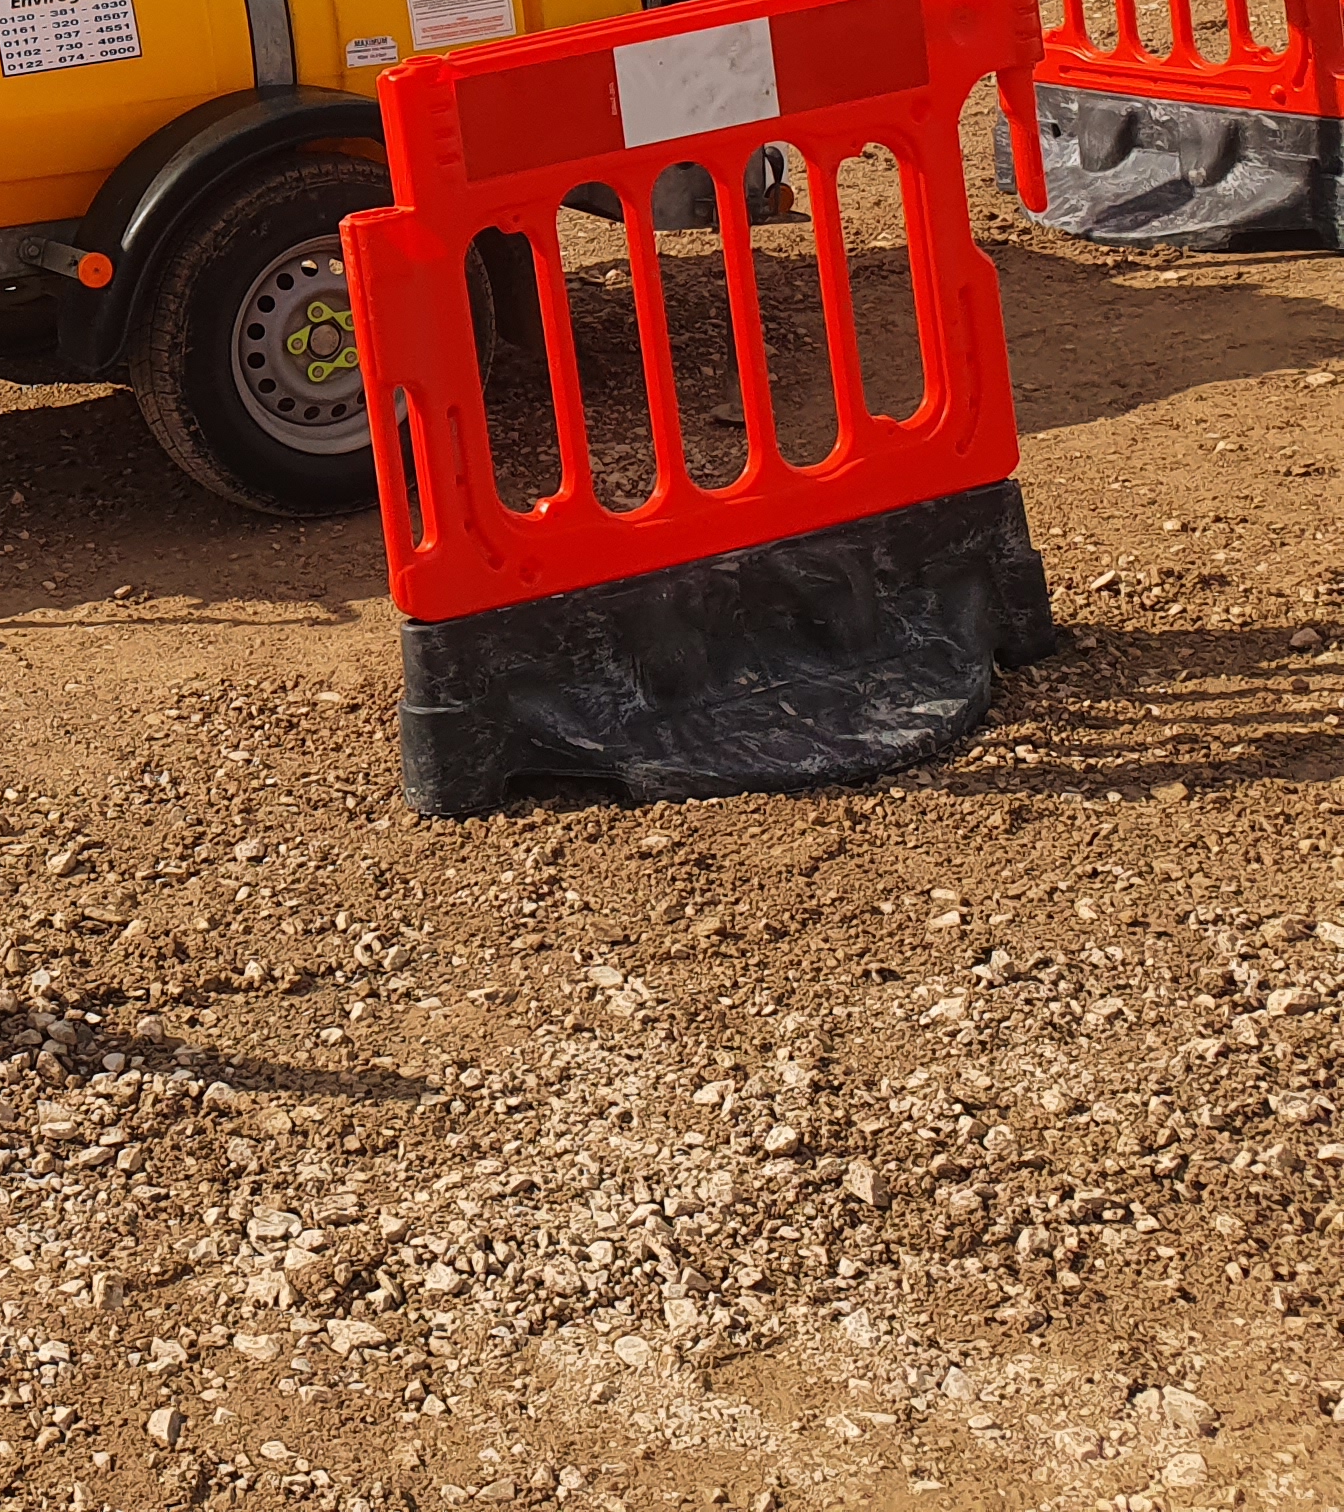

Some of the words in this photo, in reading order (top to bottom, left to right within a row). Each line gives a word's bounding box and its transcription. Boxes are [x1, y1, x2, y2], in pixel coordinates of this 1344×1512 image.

[0, 13, 35, 24] 0130
[92, 0, 127, 10] 4930
[1, 25, 36, 36] 0161
[52, 19, 79, 28] 320
[3, 36, 38, 47] 0117
[54, 30, 80, 40] 937
[56, 42, 83, 51] 730
[354, 37, 387, 47] MAXIMUM
[7, 60, 43, 71] 0122
[100, 46, 135, 57] 0900
